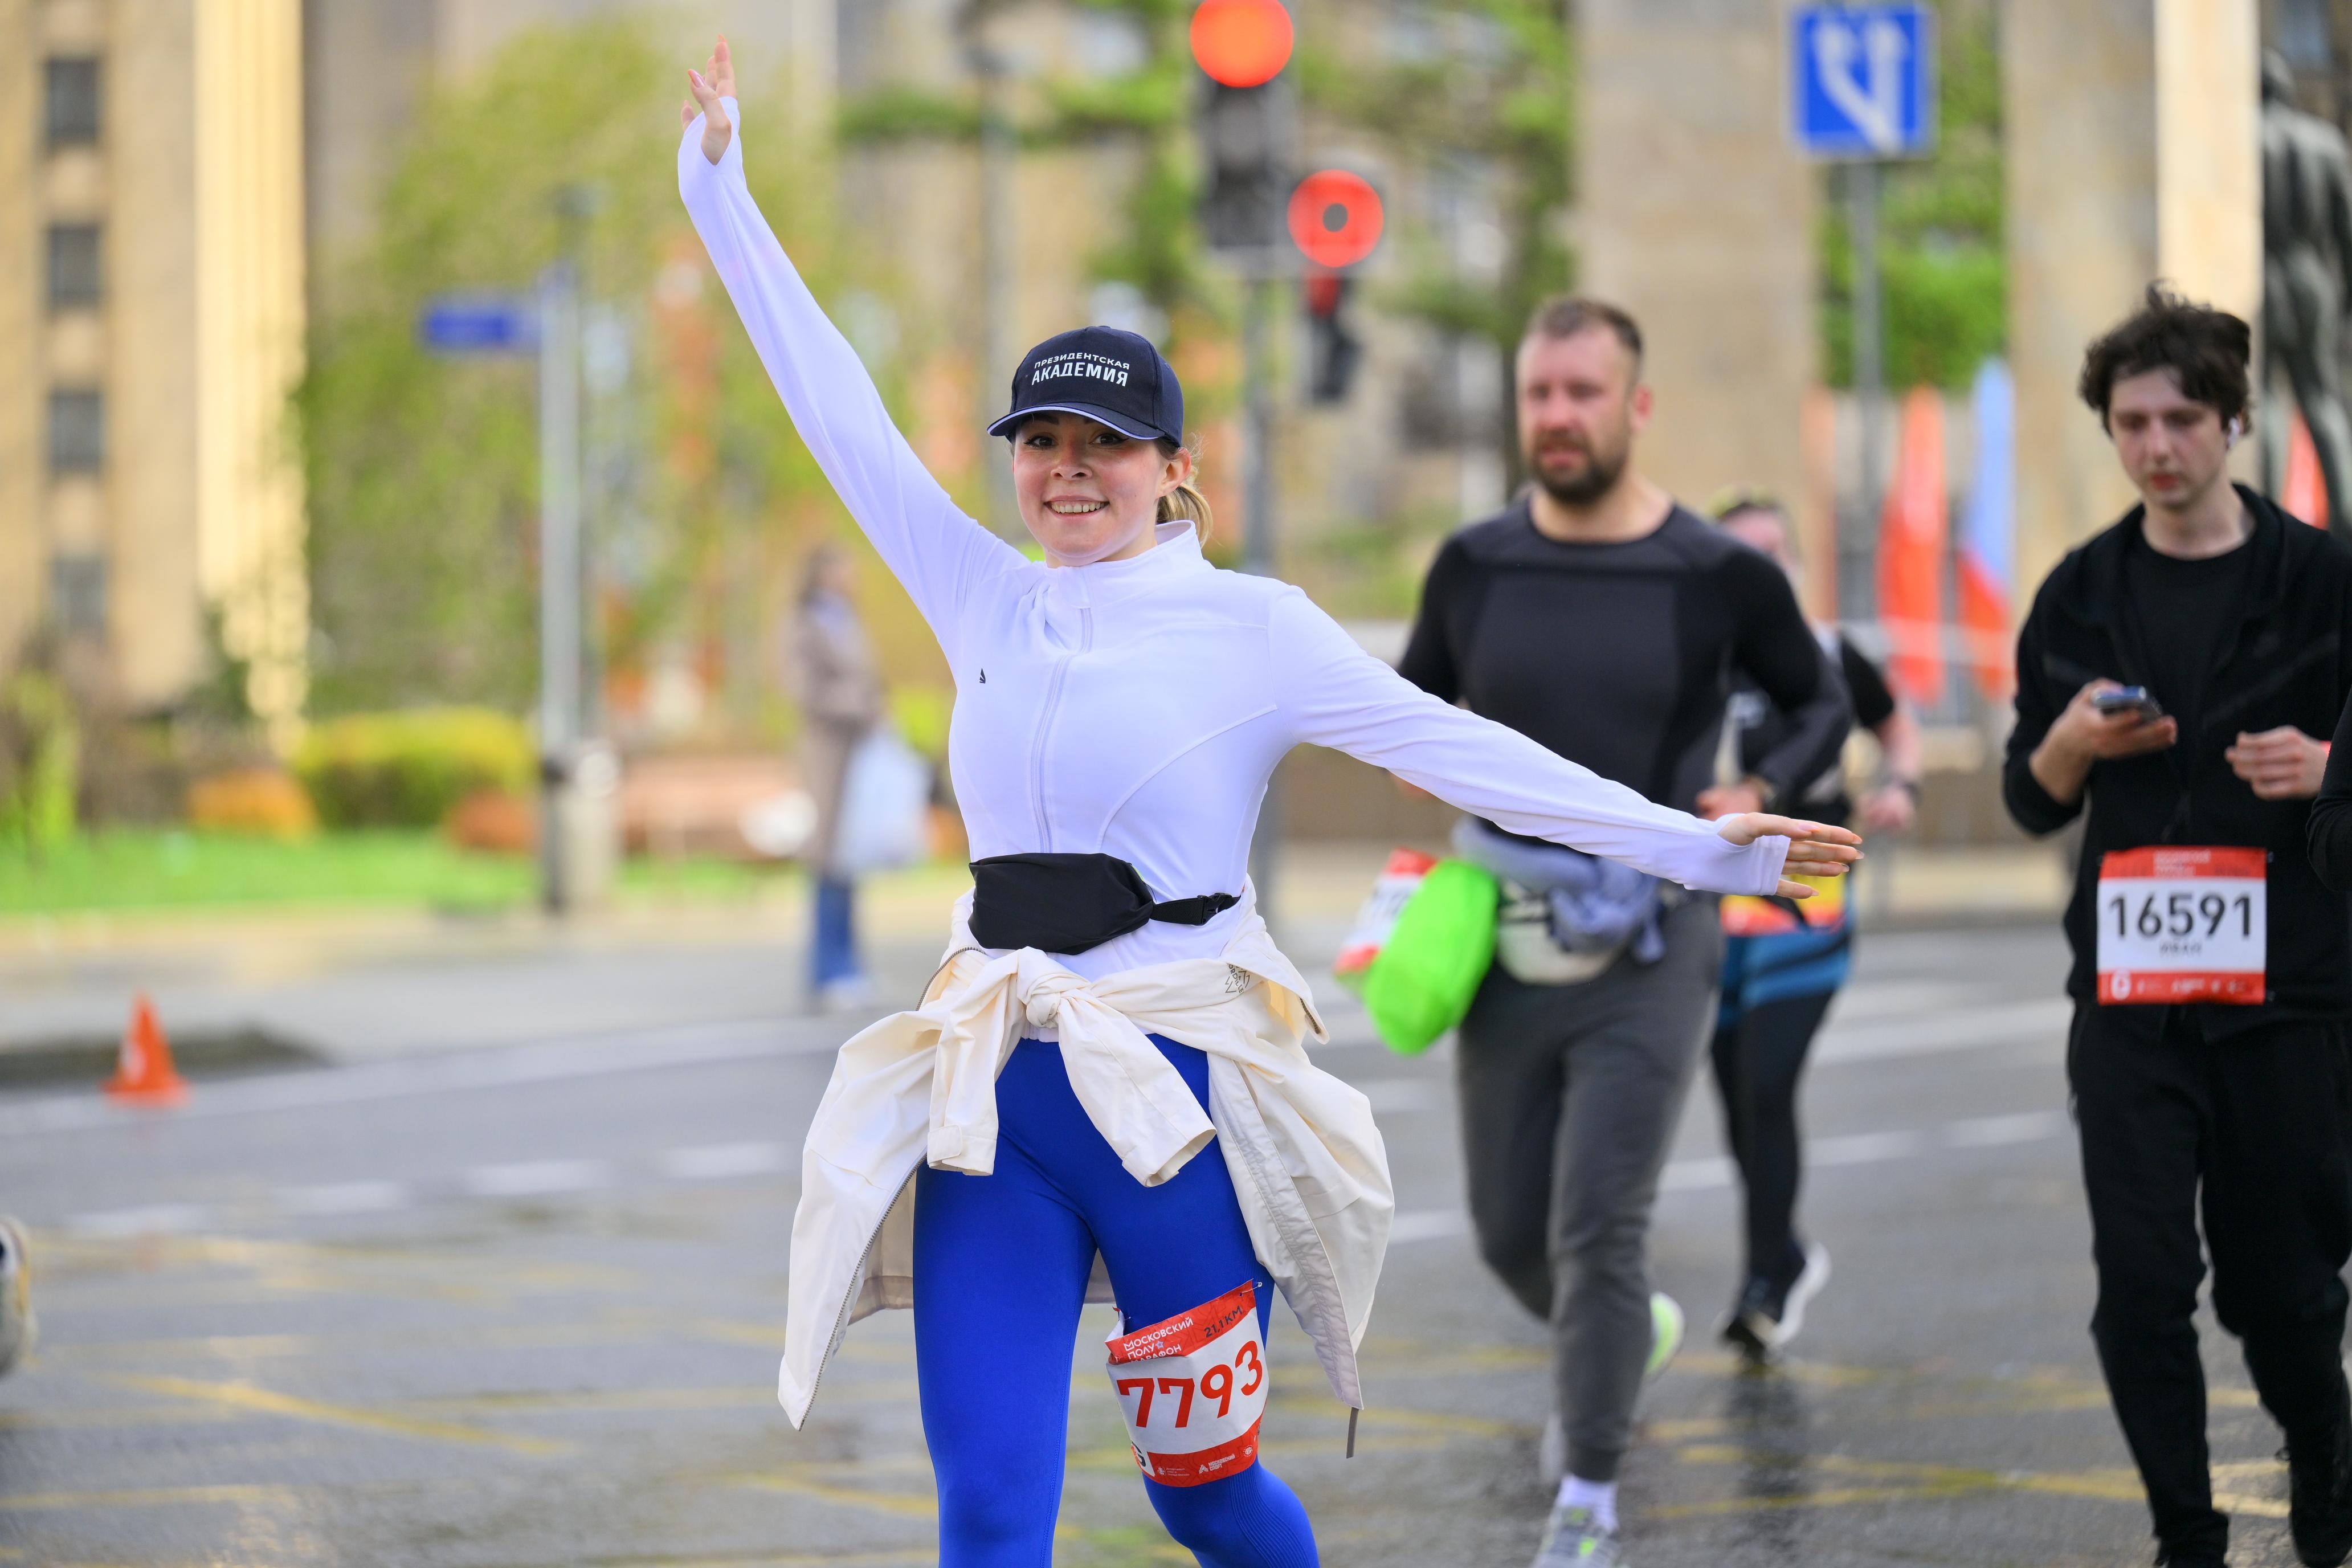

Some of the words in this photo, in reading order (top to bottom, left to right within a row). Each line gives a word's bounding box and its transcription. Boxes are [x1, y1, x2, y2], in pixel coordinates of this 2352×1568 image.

[1034, 352, 1130, 370] ПРЕЗИДЕНТСКАЯ
[1031, 362, 1129, 387] АКАДЕМИЯ
[2109, 892, 2251, 938] 16591
[1228, 964, 1244, 993] ORDILLE
[1123, 1317, 1194, 1351] МОСКОВСКИЙ
[1127, 1342, 1155, 1359] ПОЛУ
[1131, 1344, 1182, 1362] АРАФОН
[1117, 1340, 1263, 1428] 7793
[1208, 1453, 1235, 1467] МОСКОВСКИЙ
